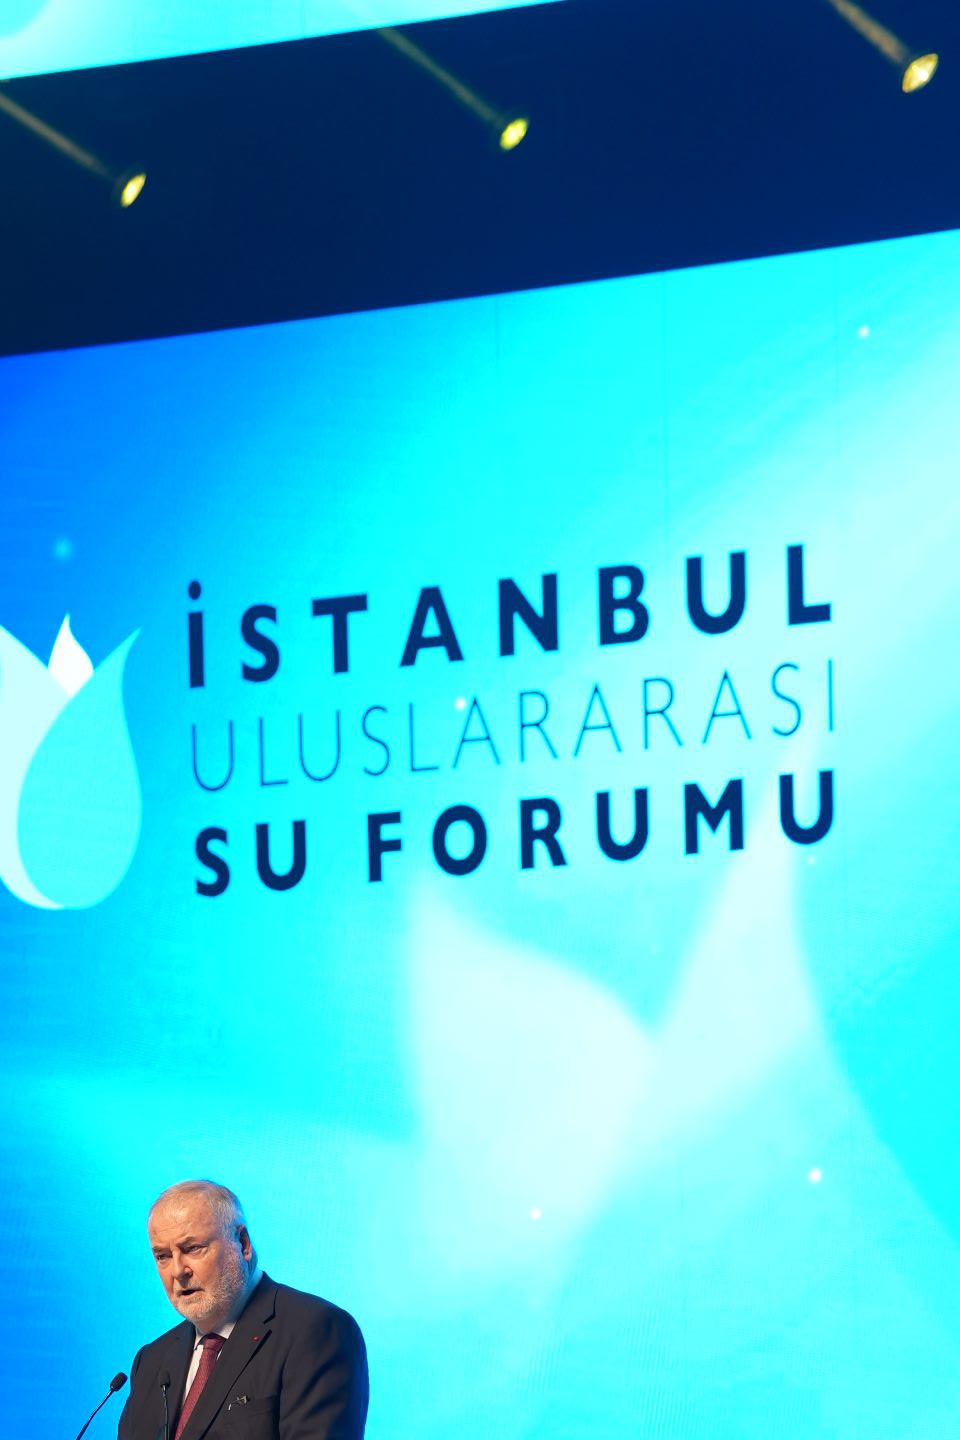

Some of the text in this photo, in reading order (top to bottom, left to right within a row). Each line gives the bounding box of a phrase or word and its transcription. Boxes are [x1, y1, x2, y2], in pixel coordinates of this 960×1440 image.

[187, 543, 833, 689] İSTANBUL
[191, 658, 835, 792] ULUSLARARASI
[194, 769, 835, 898] SU FORUMU
